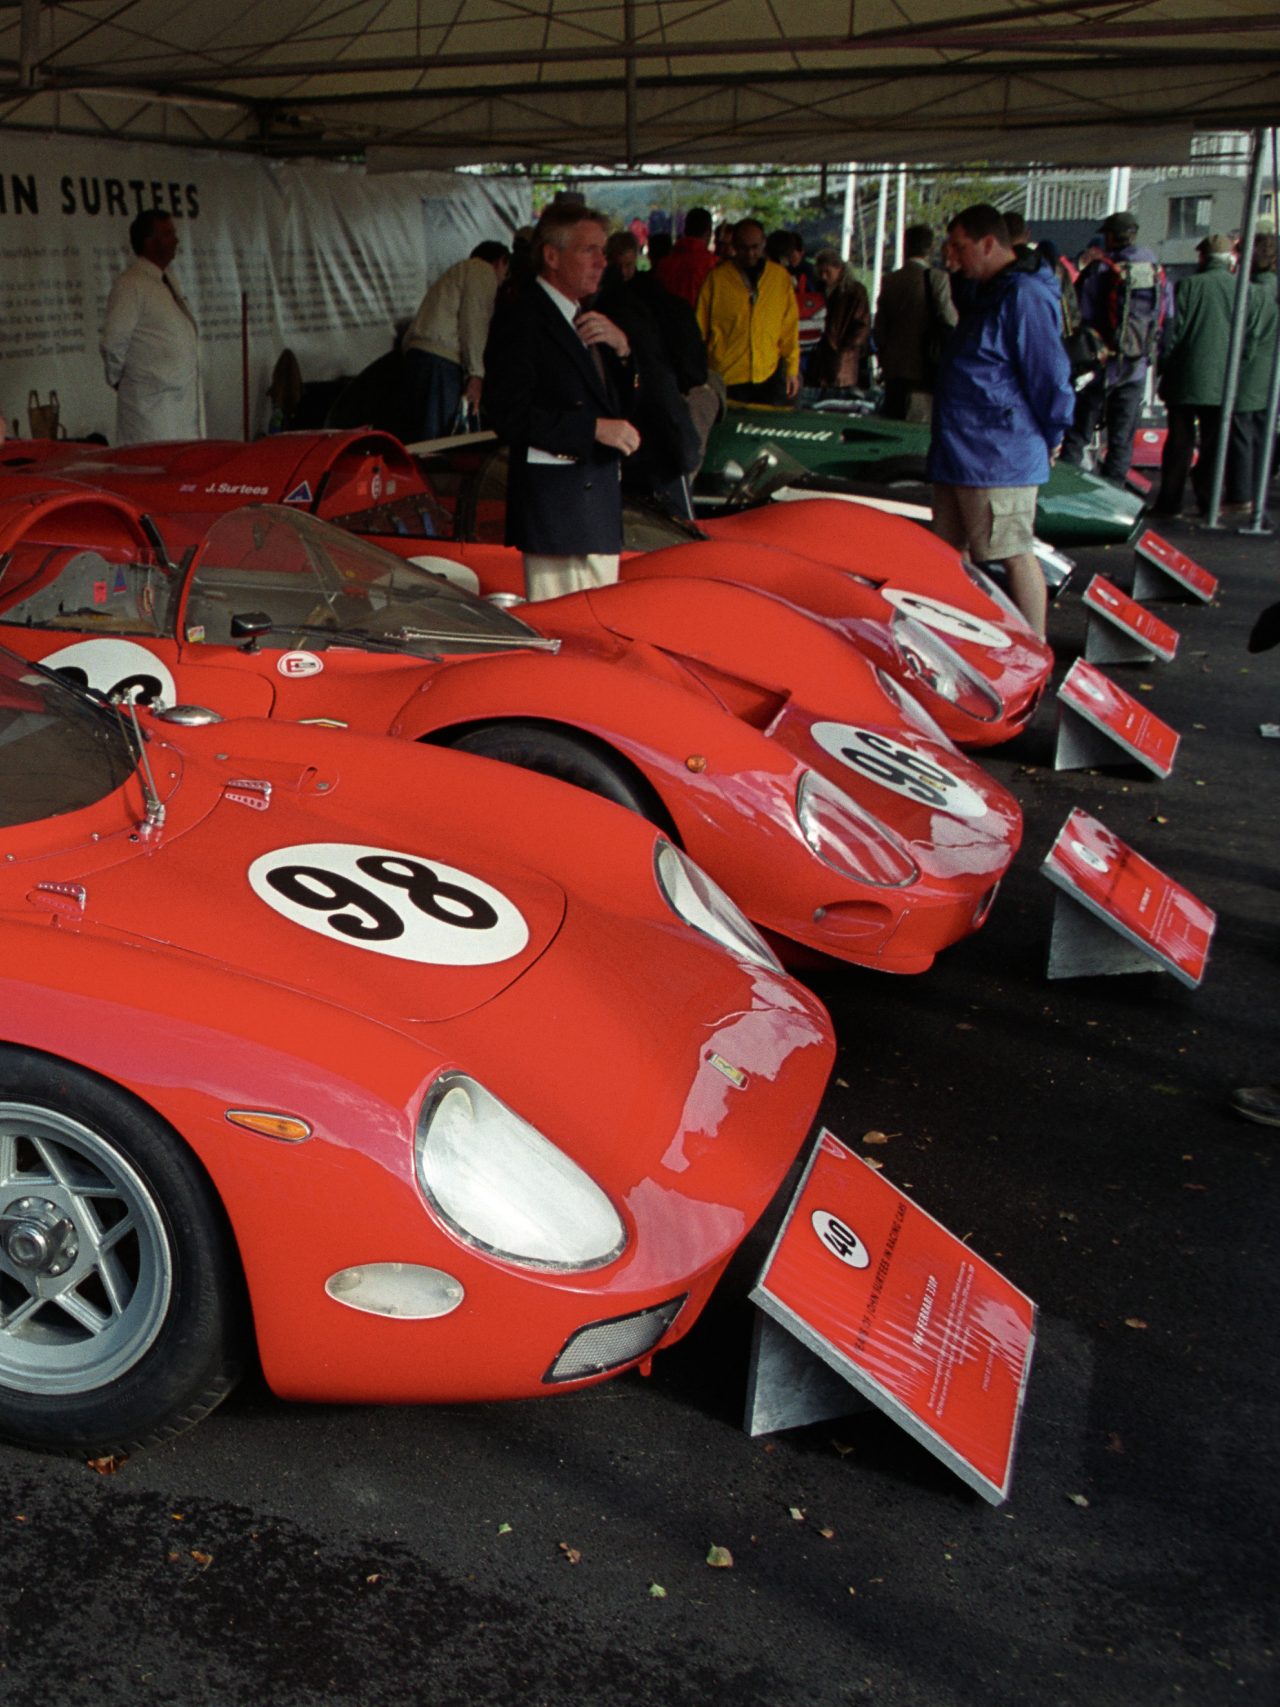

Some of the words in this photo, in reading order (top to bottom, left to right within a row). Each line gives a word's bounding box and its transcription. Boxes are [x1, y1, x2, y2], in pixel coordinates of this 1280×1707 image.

[61, 175, 200, 219] SURTEES
[841, 731, 957, 806] 96
[266, 856, 498, 940] 98
[894, 1201, 906, 1224] CARS
[823, 1218, 857, 1257] 40
[883, 1247, 892, 1260] IN
[885, 1219, 901, 1252] RACING
[872, 1257, 889, 1295] SURTEES
[866, 1292, 879, 1316] JOHN
[916, 1291, 933, 1332] FERRARI
